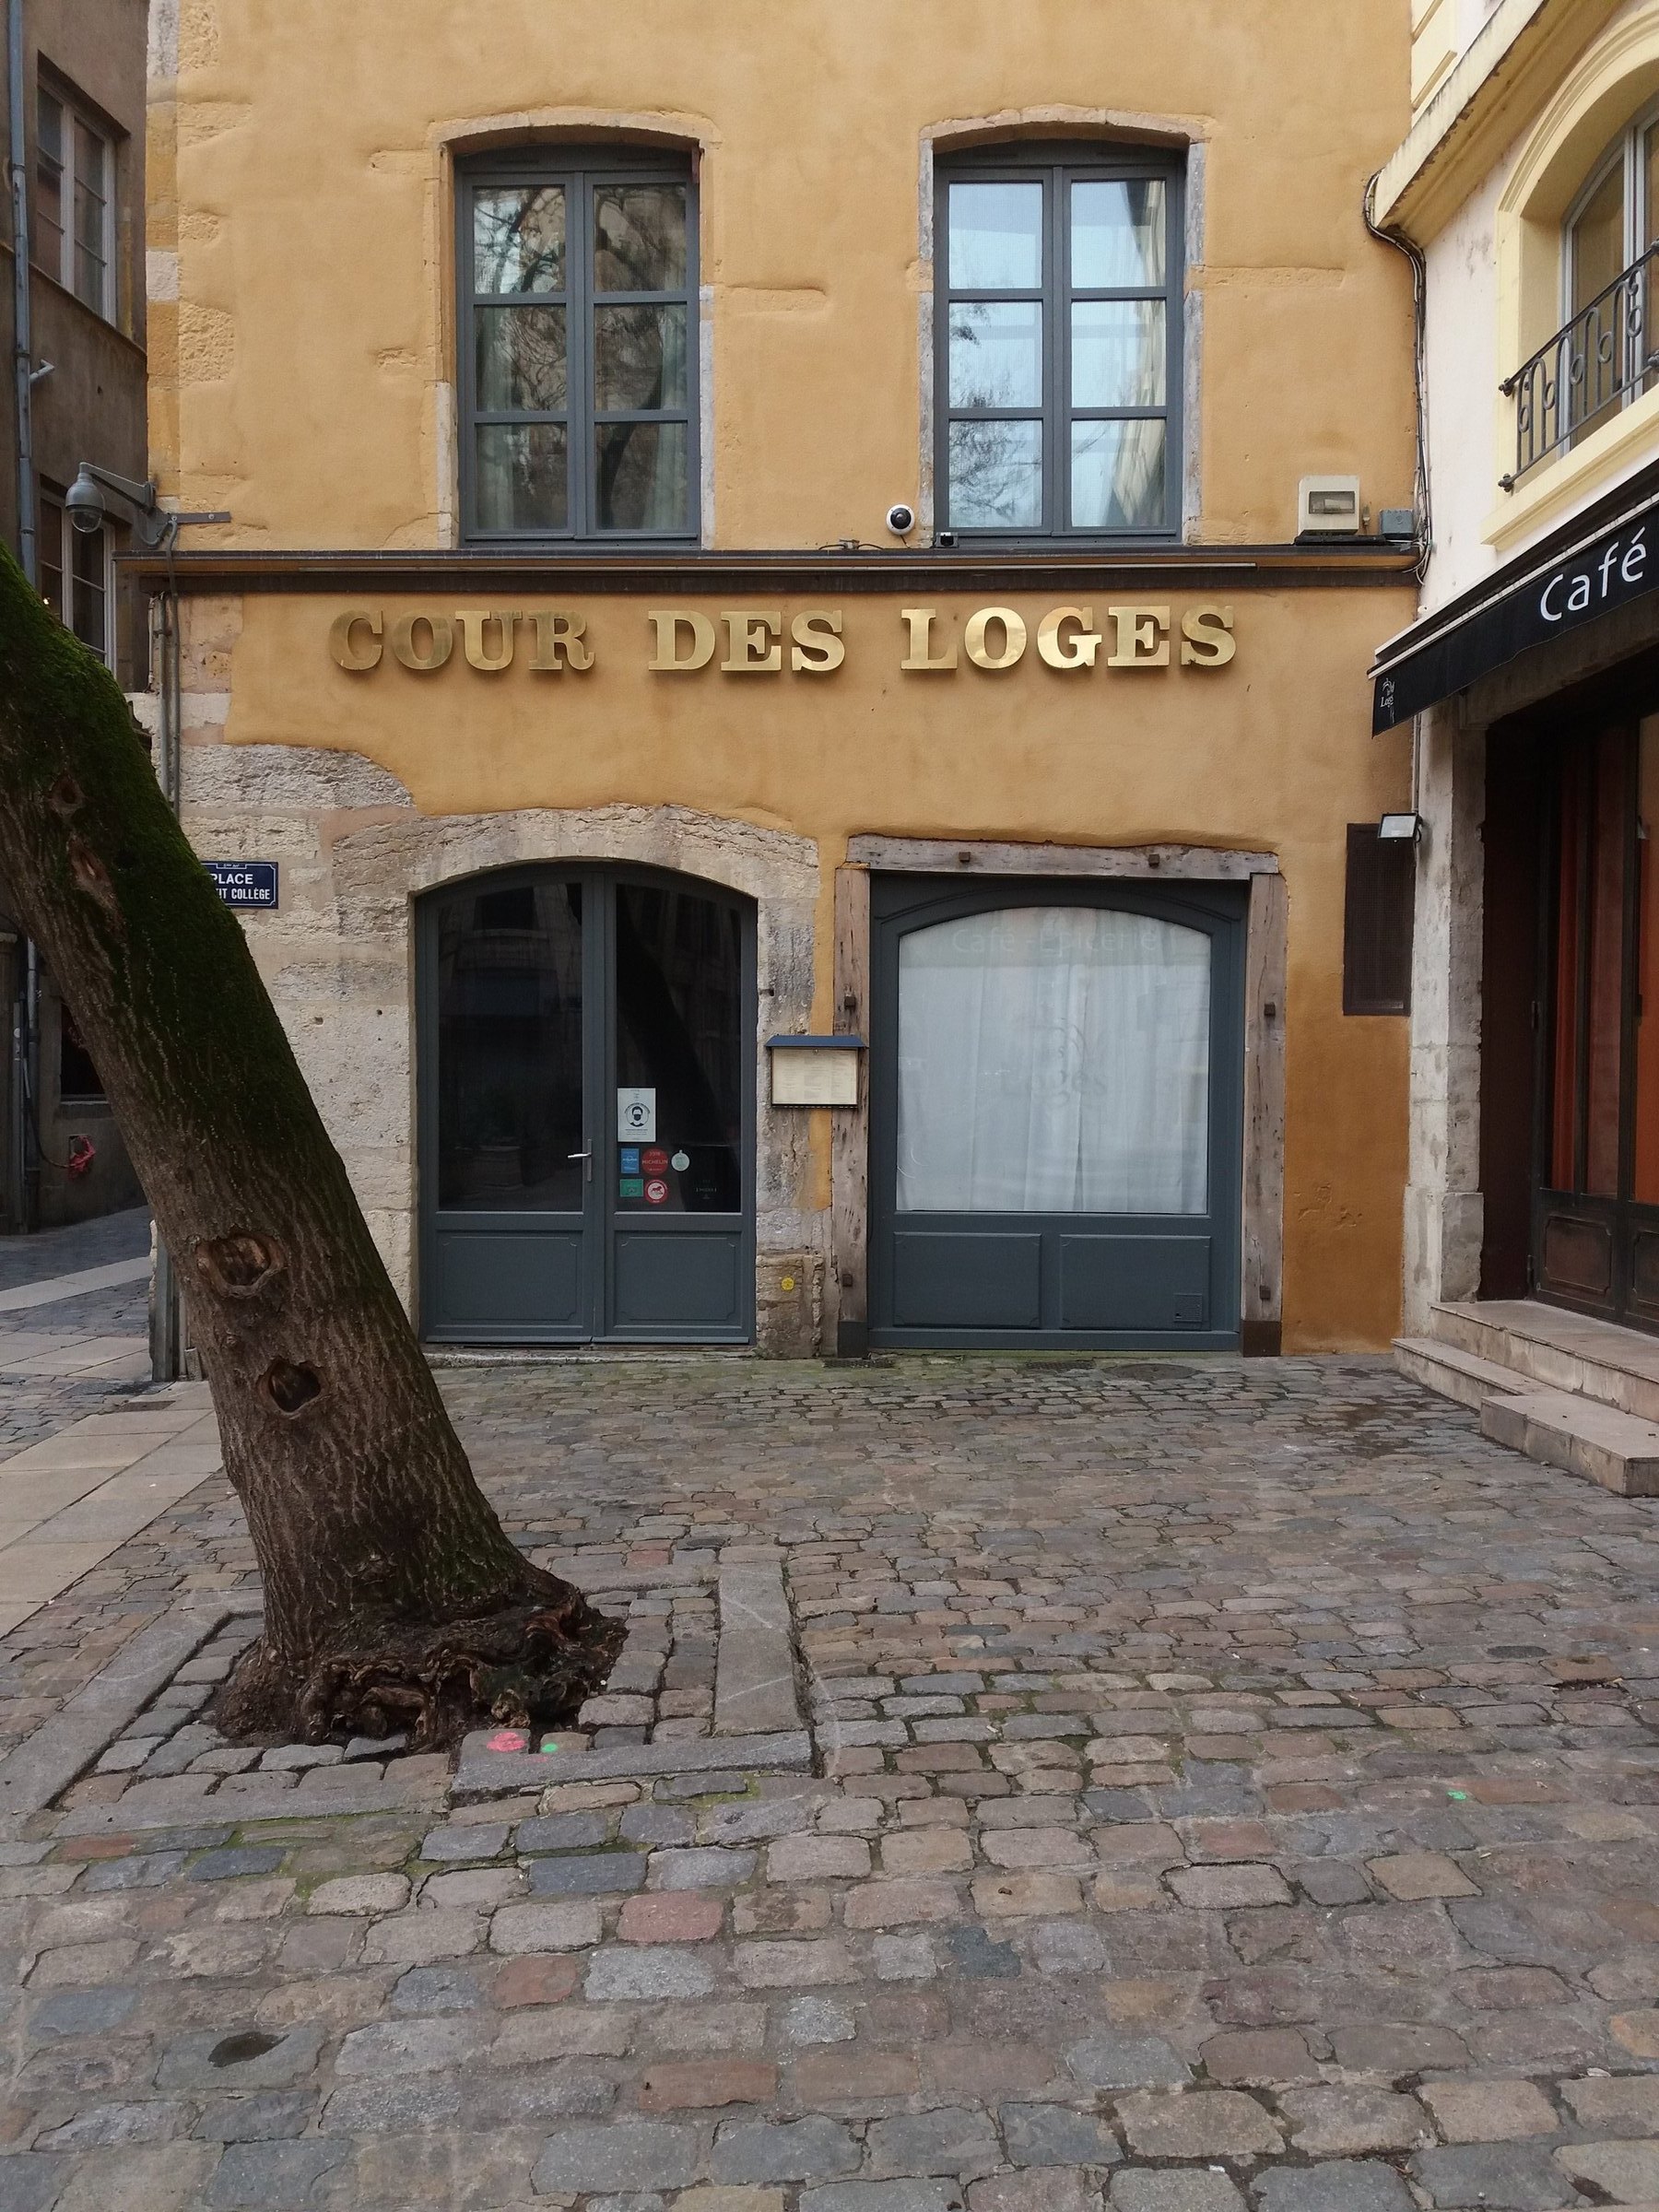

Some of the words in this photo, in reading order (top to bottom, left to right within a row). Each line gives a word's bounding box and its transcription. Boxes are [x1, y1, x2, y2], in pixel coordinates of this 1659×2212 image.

[1539, 526, 1647, 622] Café
[329, 608, 594, 672] COUR
[649, 608, 845, 672] DES
[900, 605, 1236, 671] LOGES
[231, 887, 270, 900] COLLÈGE
